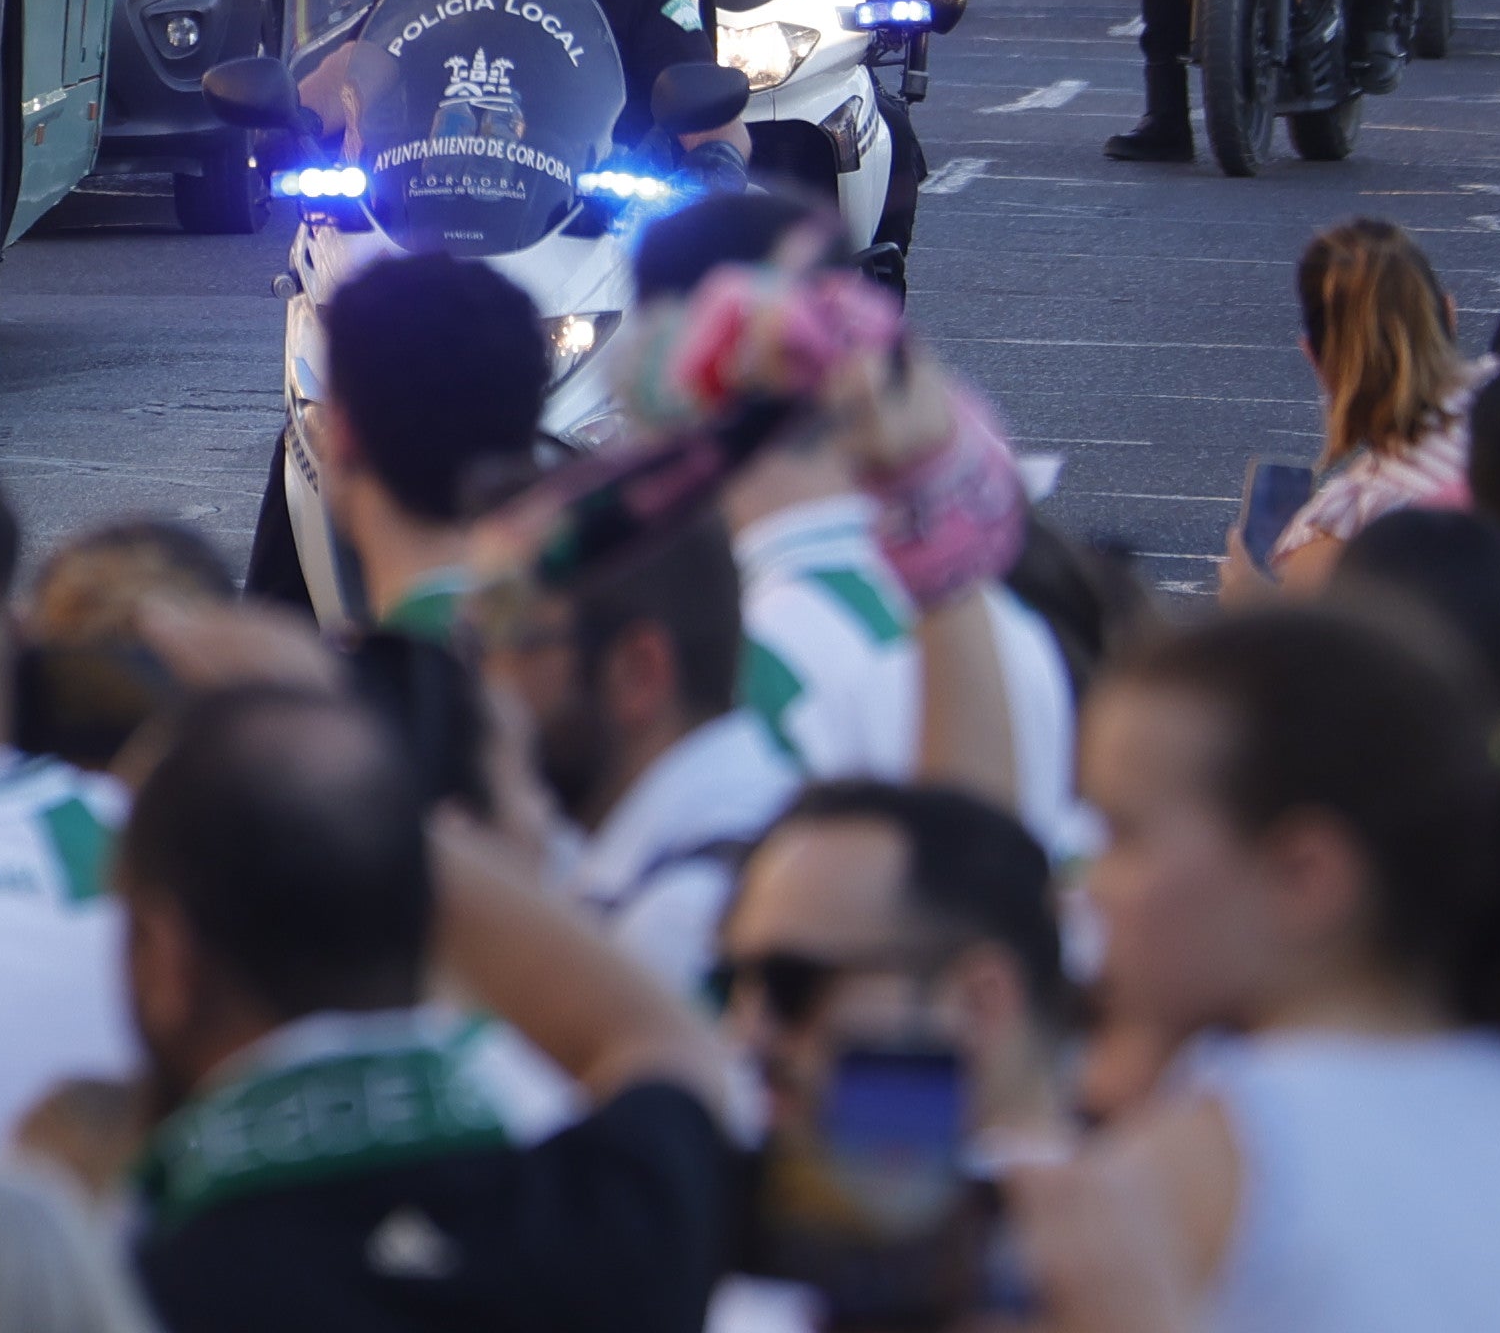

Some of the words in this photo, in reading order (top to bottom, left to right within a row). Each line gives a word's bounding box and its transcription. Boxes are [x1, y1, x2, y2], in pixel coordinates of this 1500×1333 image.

[373, 136, 486, 174] AYUNTAMIENTO
[487, 139, 504, 160] DE
[506, 141, 573, 186] CORDOBA
